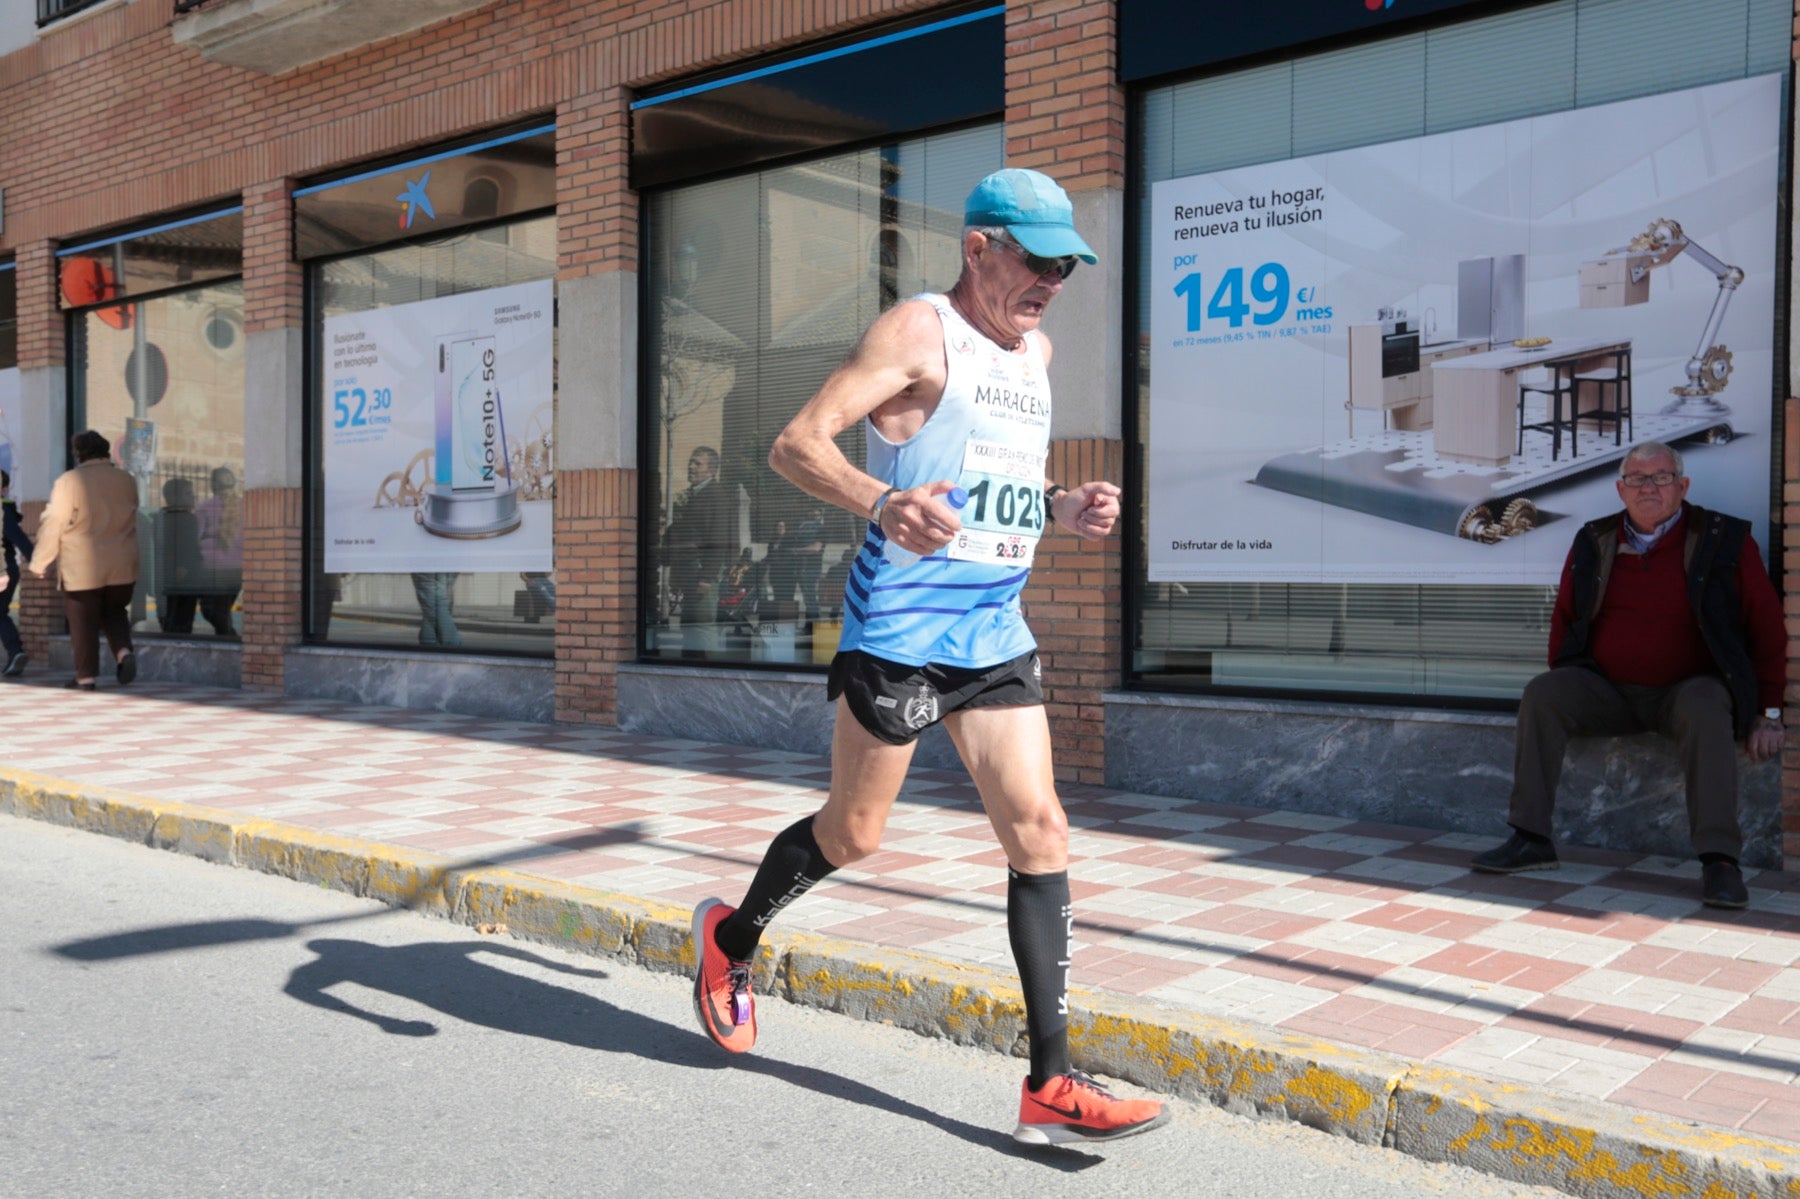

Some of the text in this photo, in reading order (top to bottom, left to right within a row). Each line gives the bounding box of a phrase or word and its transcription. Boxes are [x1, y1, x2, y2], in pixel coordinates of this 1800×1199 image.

[1174, 187, 1325, 221] Renueva tu hogar,
[1174, 206, 1322, 241] renueva tu ilusión
[1173, 254, 1198, 270] por
[1173, 262, 1290, 332] 149
[1296, 306, 1333, 321] mes
[1173, 339, 1184, 348] en
[1185, 337, 1195, 346] 72
[1197, 335, 1222, 345] meses
[1223, 332, 1244, 344] (9,45
[1257, 330, 1271, 339] TIN
[1279, 327, 1297, 338] 9,87
[1312, 324, 1332, 335] TAE)
[482, 349, 495, 482] Note10+ 5G
[968, 479, 1043, 531] 1025
[1171, 540, 1273, 550] Disfrutar de la vida
